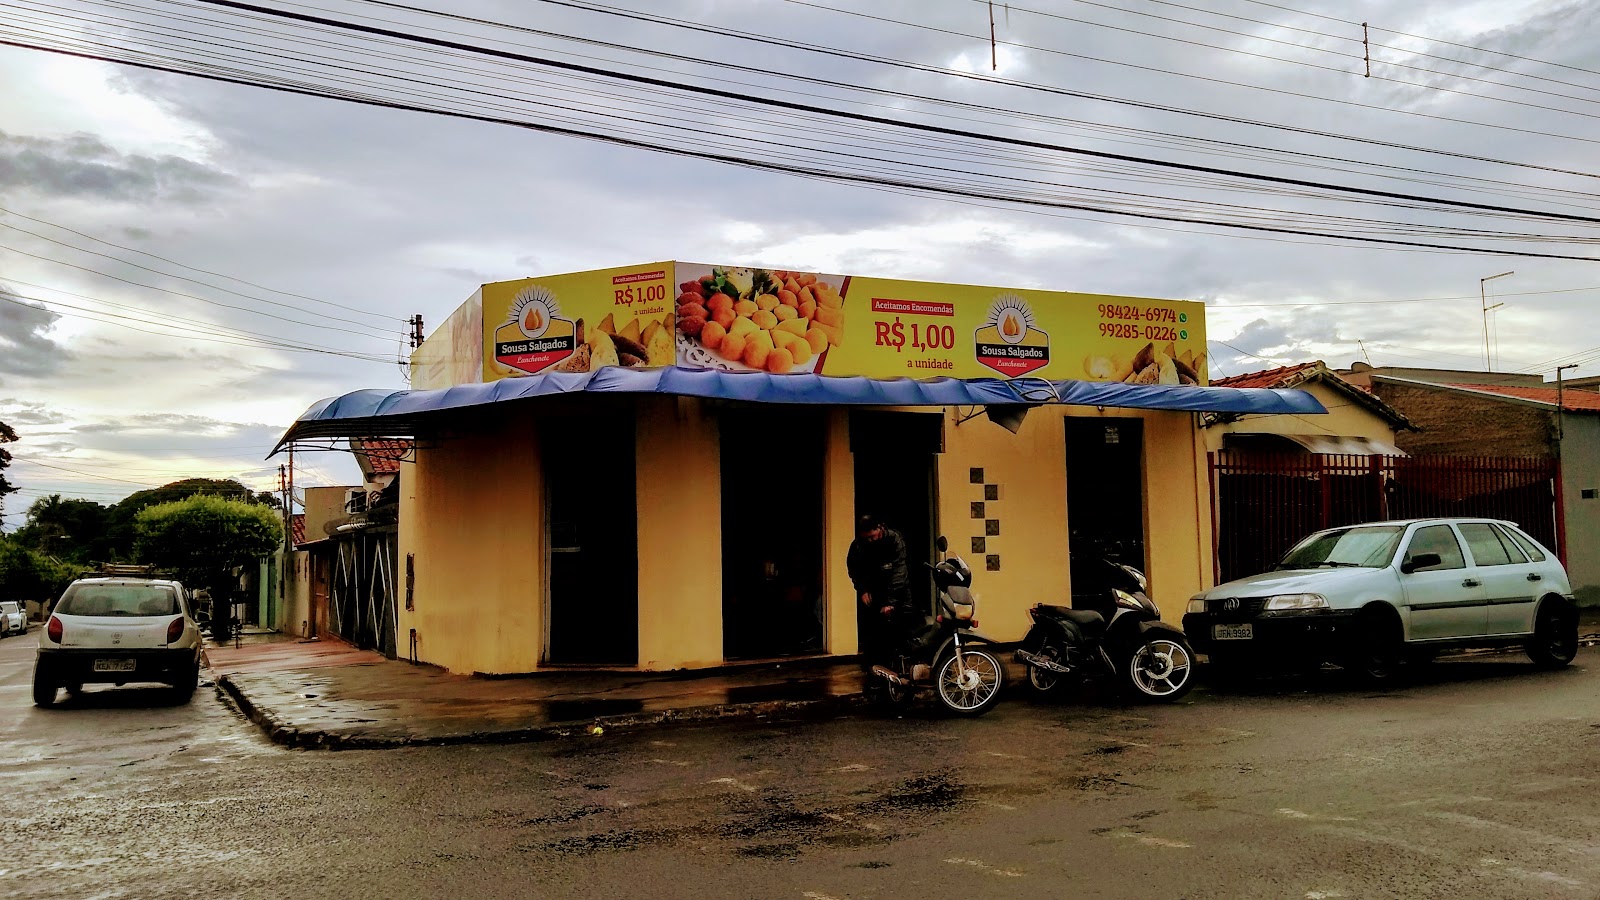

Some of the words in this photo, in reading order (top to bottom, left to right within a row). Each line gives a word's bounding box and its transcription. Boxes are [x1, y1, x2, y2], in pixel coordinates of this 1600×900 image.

[615, 285, 634, 307] R$
[636, 284, 666, 305] 1,00
[639, 306, 664, 315] unidade
[874, 300, 911, 311] Aceitamos
[911, 303, 954, 314] Encomendas
[1097, 303, 1177, 323] 98424-6974
[874, 316, 906, 353] R$
[910, 323, 955, 353] 1,00
[1098, 322, 1178, 341] 99285-0226
[501, 344, 528, 354] Sousa
[528, 339, 568, 352] Salgados
[981, 345, 1007, 356] Sousa
[1007, 346, 1043, 359] Salgados
[907, 360, 913, 368] a
[915, 358, 954, 370] unidade
